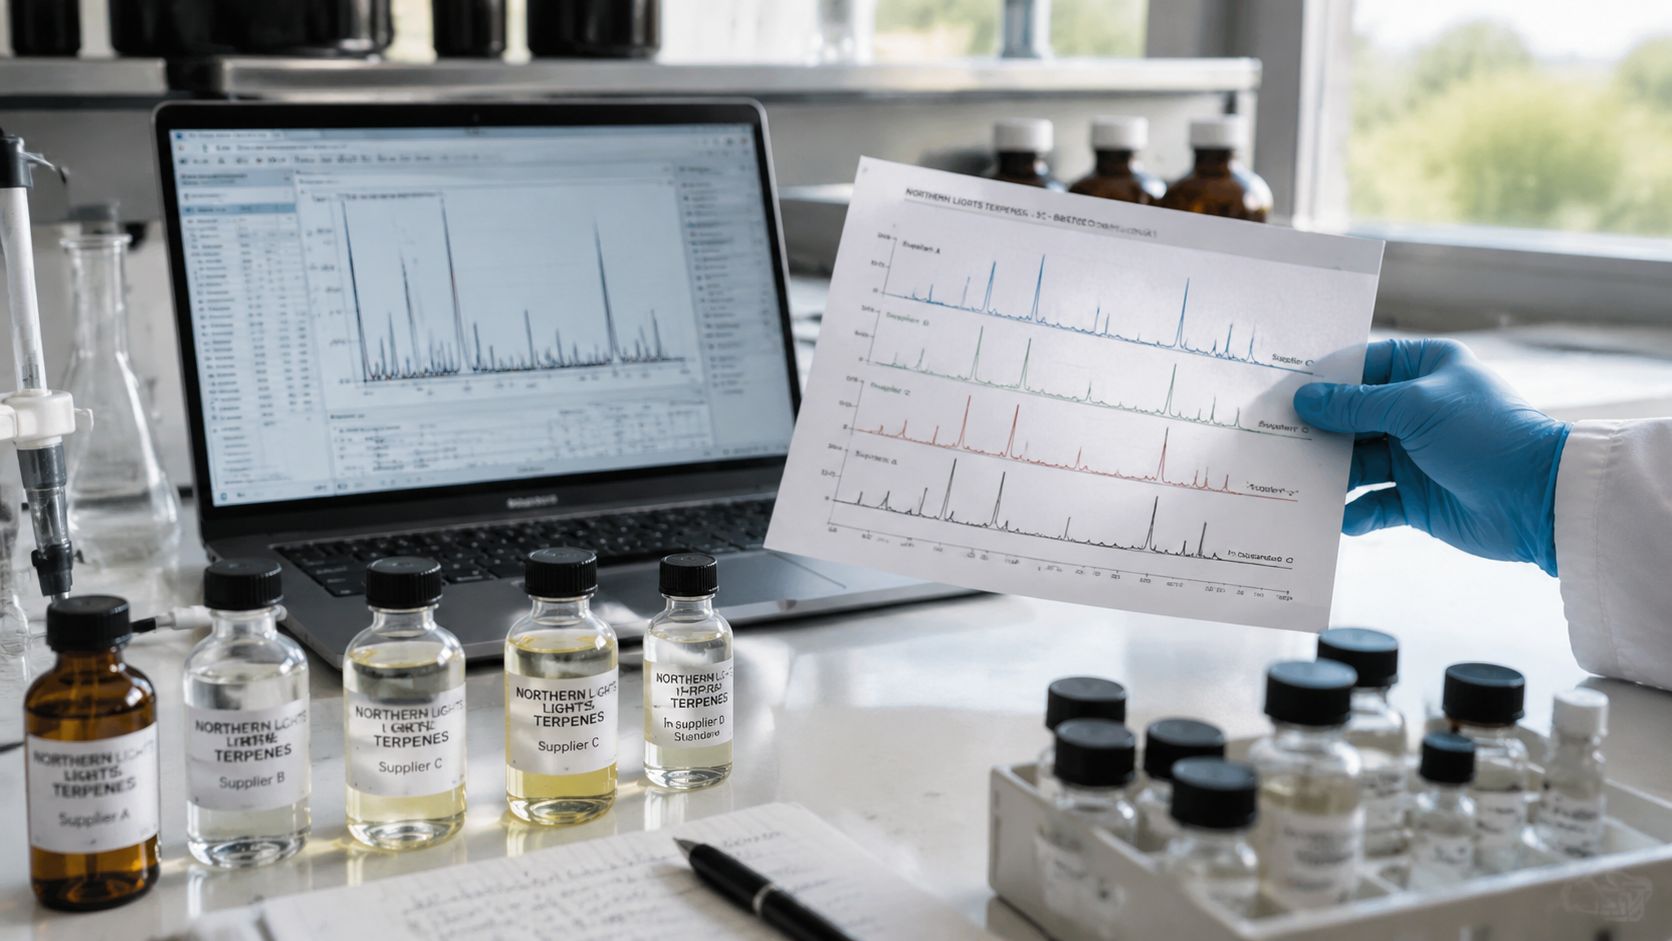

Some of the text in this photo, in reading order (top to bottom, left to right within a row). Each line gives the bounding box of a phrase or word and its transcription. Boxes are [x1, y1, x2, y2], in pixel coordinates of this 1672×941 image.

[656, 672, 714, 684] NORTHERN
[516, 687, 586, 701] NORTHERN
[671, 692, 728, 708] TERPENES
[355, 706, 428, 720] NORTHERN
[534, 711, 605, 727] TERPENES
[195, 720, 271, 734] NORTHERN
[373, 730, 449, 748] TERPENES
[538, 737, 599, 754] Supplier C
[33, 750, 112, 767] NORTHERN
[214, 743, 292, 763] TERPENES
[379, 758, 442, 775] Supplier C
[52, 776, 136, 798] TERPENES
[219, 771, 285, 791] Supplier B
[120, 808, 130, 821] A
